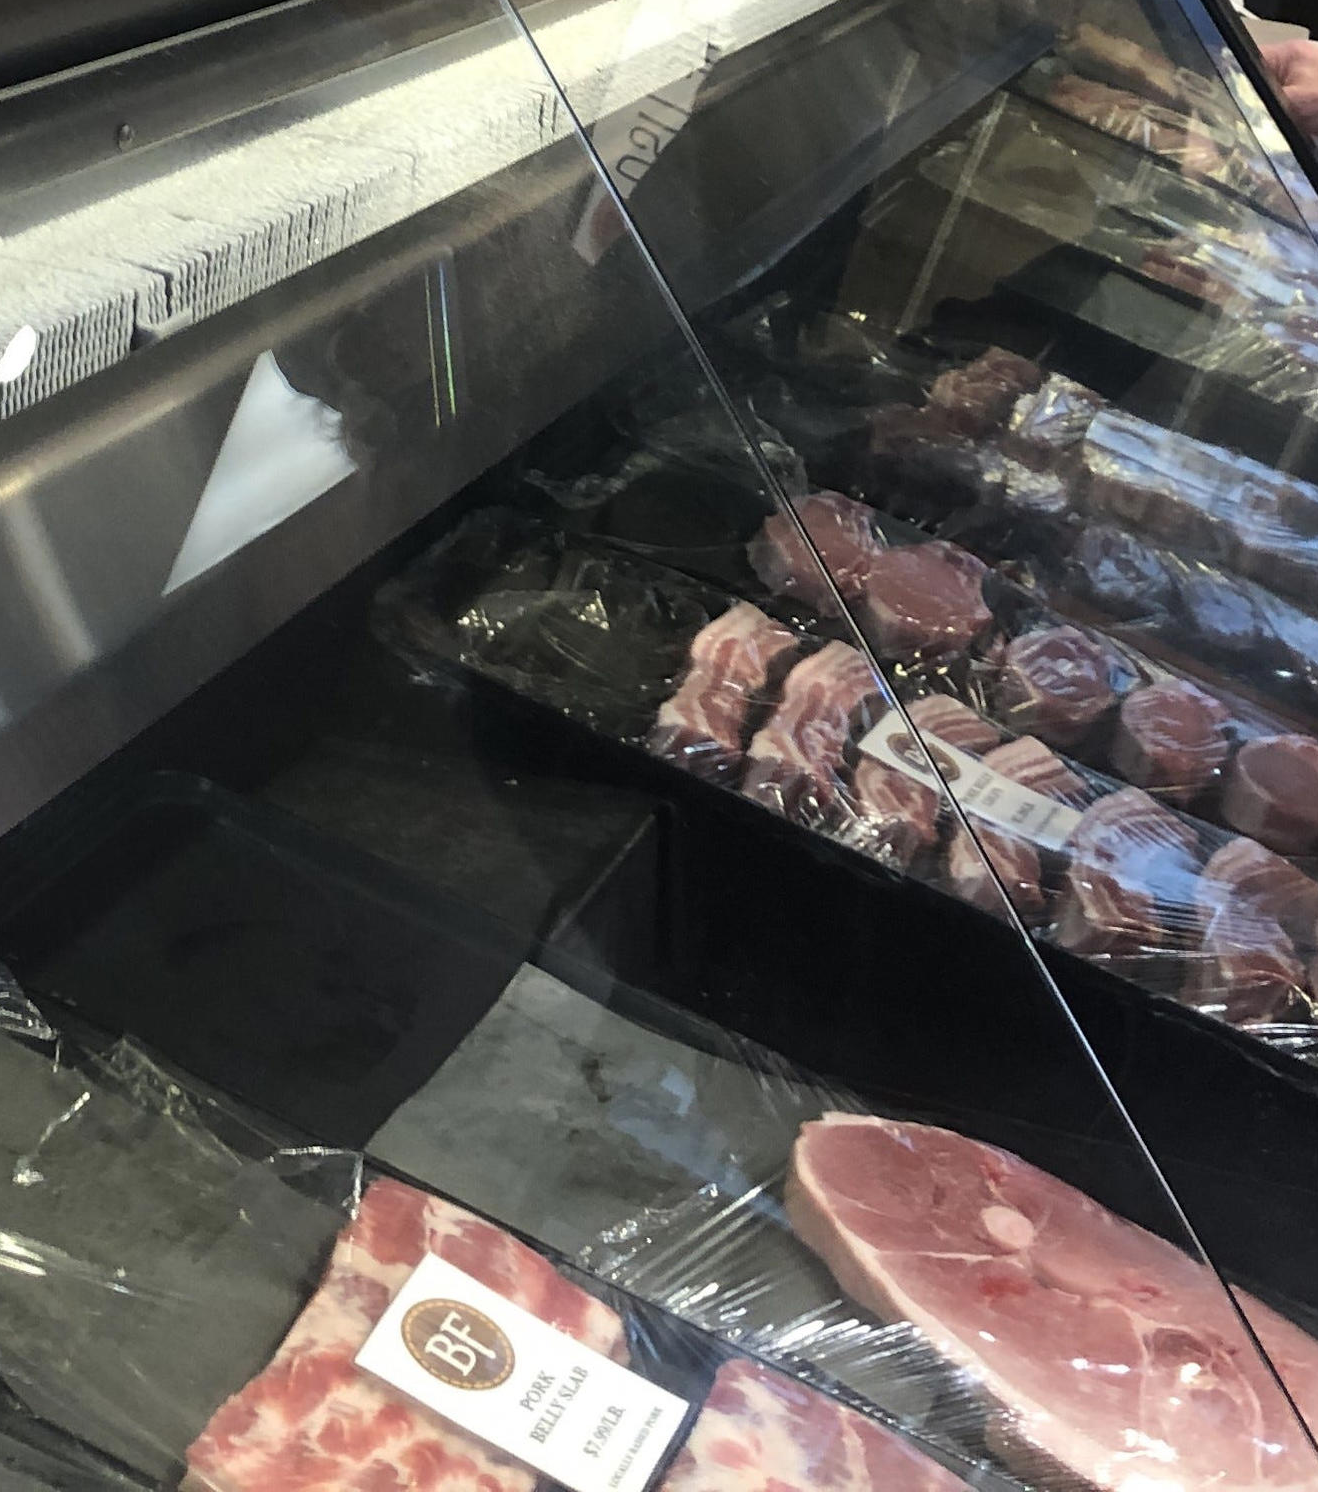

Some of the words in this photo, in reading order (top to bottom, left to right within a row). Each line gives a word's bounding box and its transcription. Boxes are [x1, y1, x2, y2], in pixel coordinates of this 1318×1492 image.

[425, 1311, 496, 1377] BF
[520, 1369, 556, 1412] PORK
[529, 1397, 566, 1444] BELLY
[557, 1365, 589, 1401] SLAB
